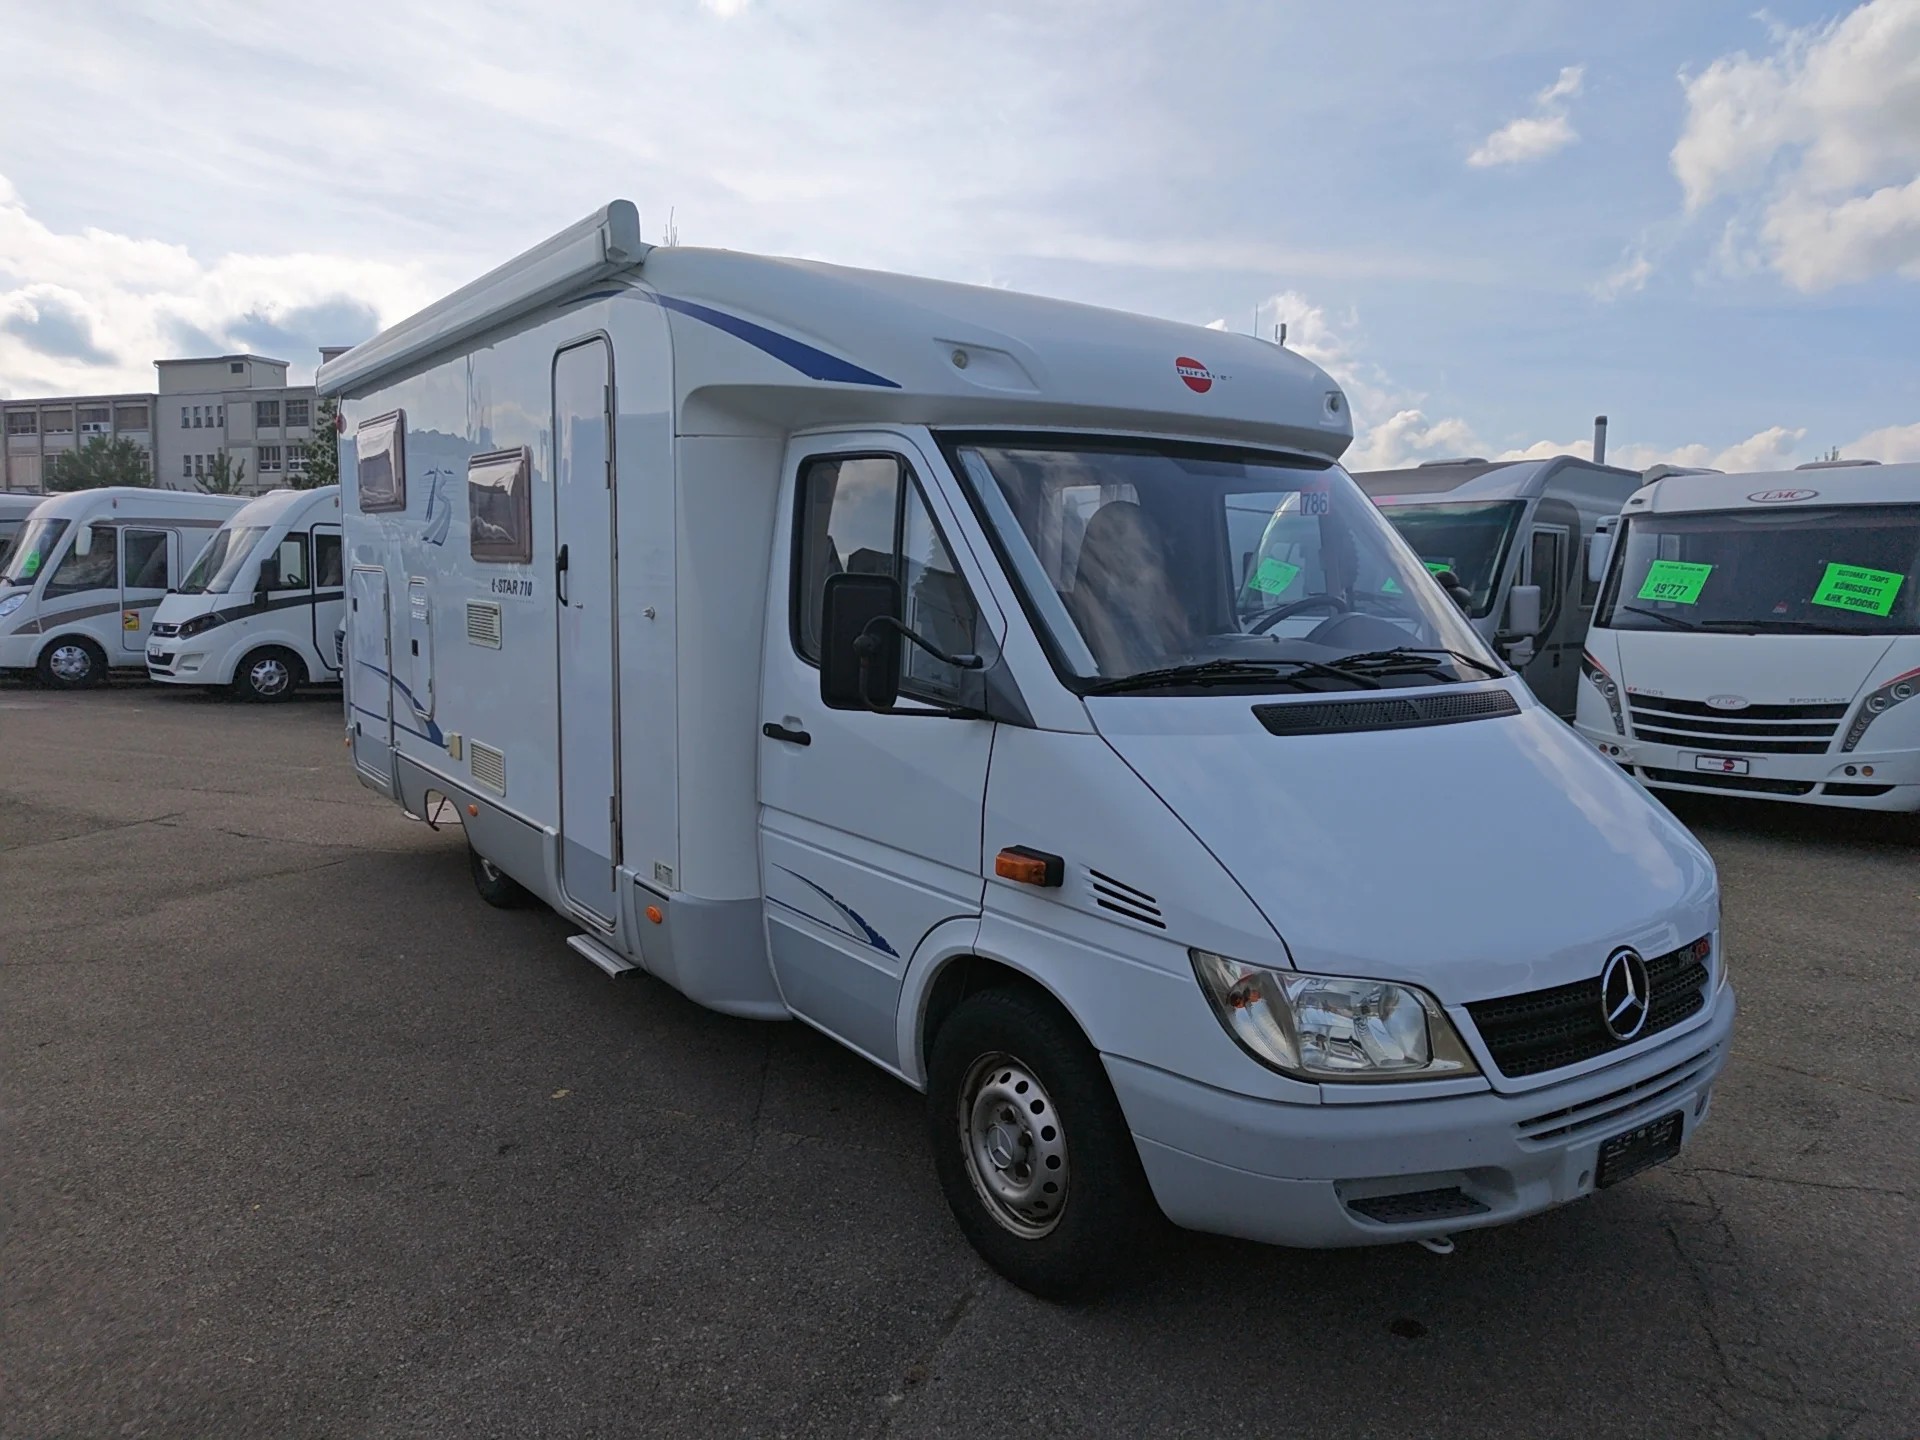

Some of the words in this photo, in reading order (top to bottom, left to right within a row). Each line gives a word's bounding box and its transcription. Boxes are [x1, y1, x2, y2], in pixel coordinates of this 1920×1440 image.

[1302, 492, 1328, 514] 786
[1869, 574, 1891, 584] 150PS
[519, 580, 533, 597] 710
